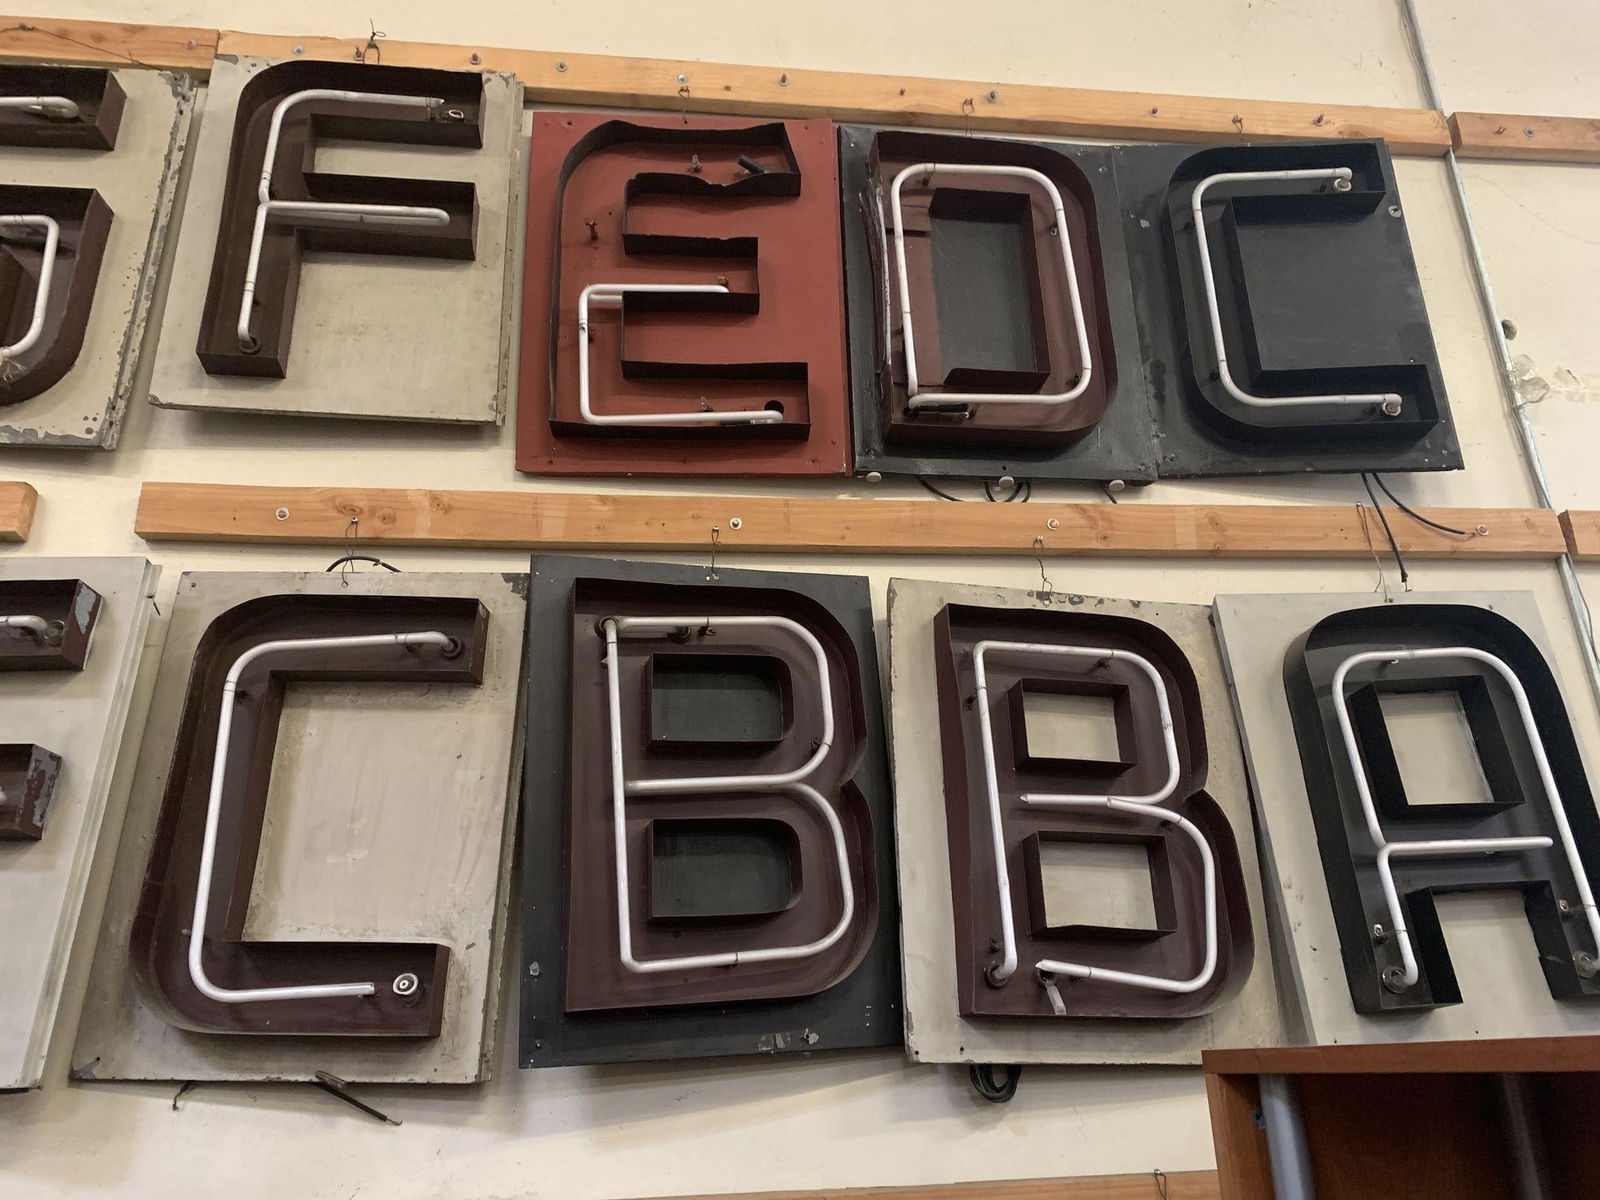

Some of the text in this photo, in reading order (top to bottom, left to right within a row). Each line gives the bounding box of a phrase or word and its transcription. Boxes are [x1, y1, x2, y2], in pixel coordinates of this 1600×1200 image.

[196, 60, 486, 378] F
[549, 119, 811, 440] E
[862, 131, 1118, 446] D
[1166, 143, 1439, 446] C
[129, 594, 490, 1037] C
[563, 577, 878, 1013] B
[933, 603, 1255, 1019] B
[1282, 603, 1600, 1015] A
